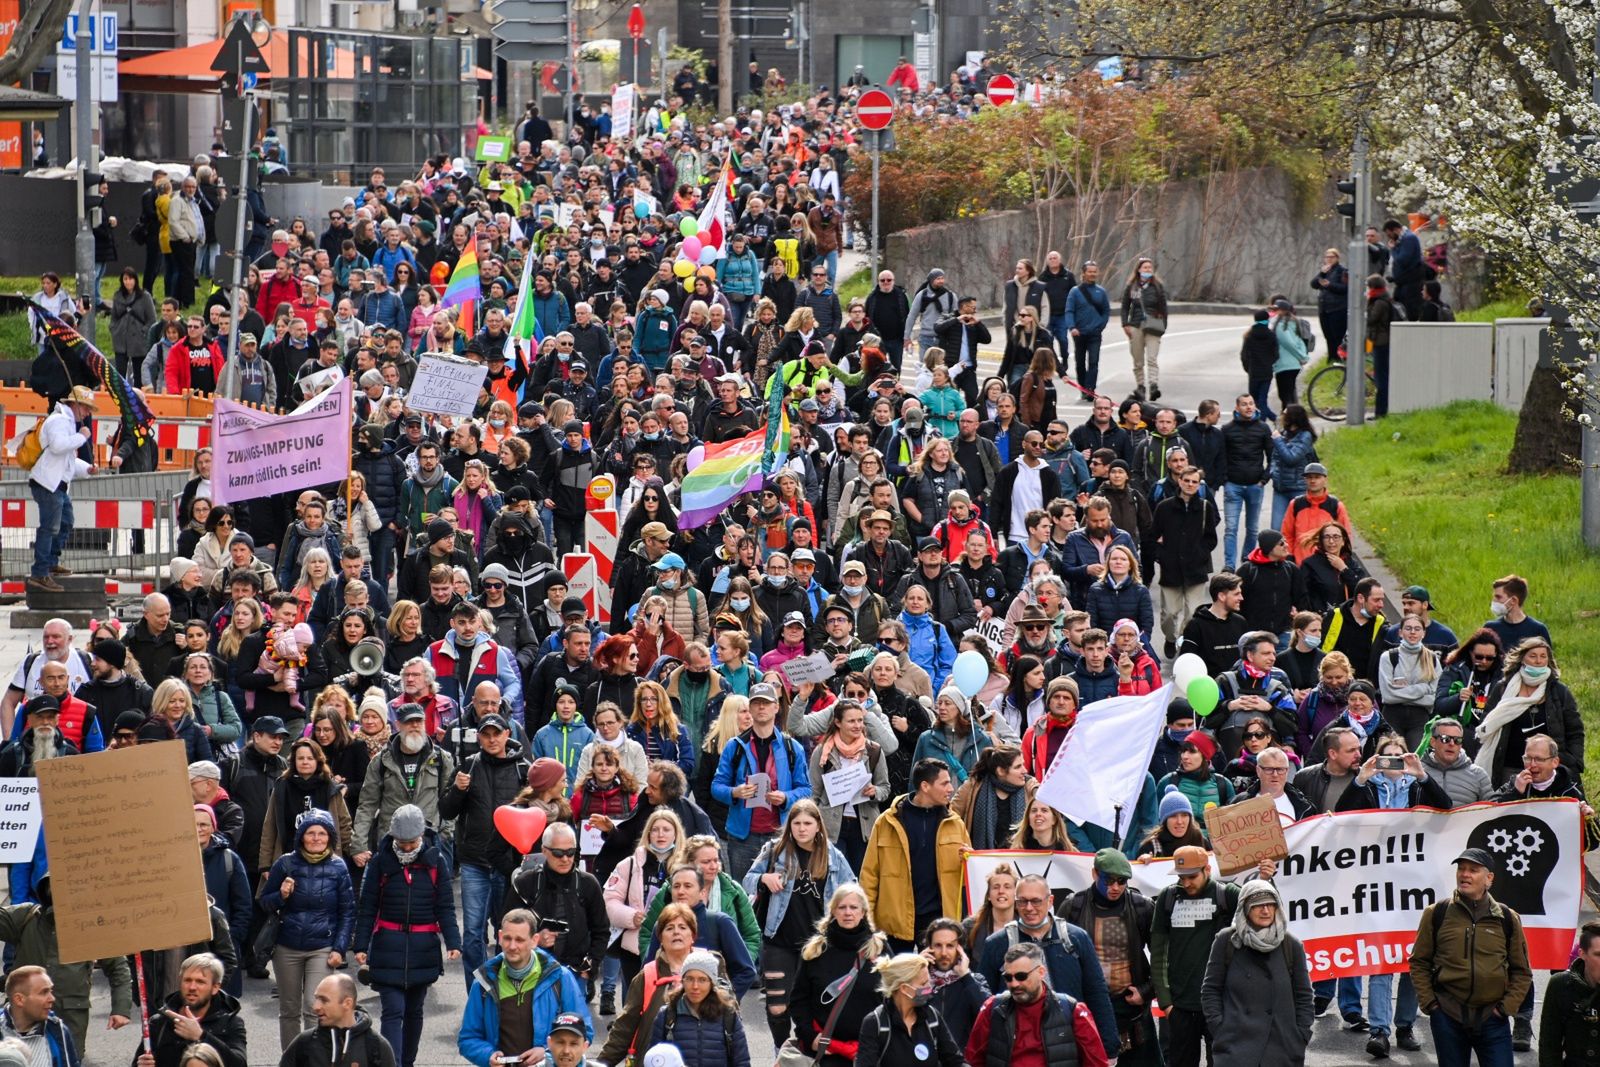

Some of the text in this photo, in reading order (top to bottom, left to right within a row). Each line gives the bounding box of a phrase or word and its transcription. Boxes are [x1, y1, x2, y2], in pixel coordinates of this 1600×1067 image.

[227, 433, 324, 464] ZWANGS-IMPFUNG
[228, 474, 254, 488] kann
[291, 457, 322, 475] sein!
[5, 802, 30, 811] und
